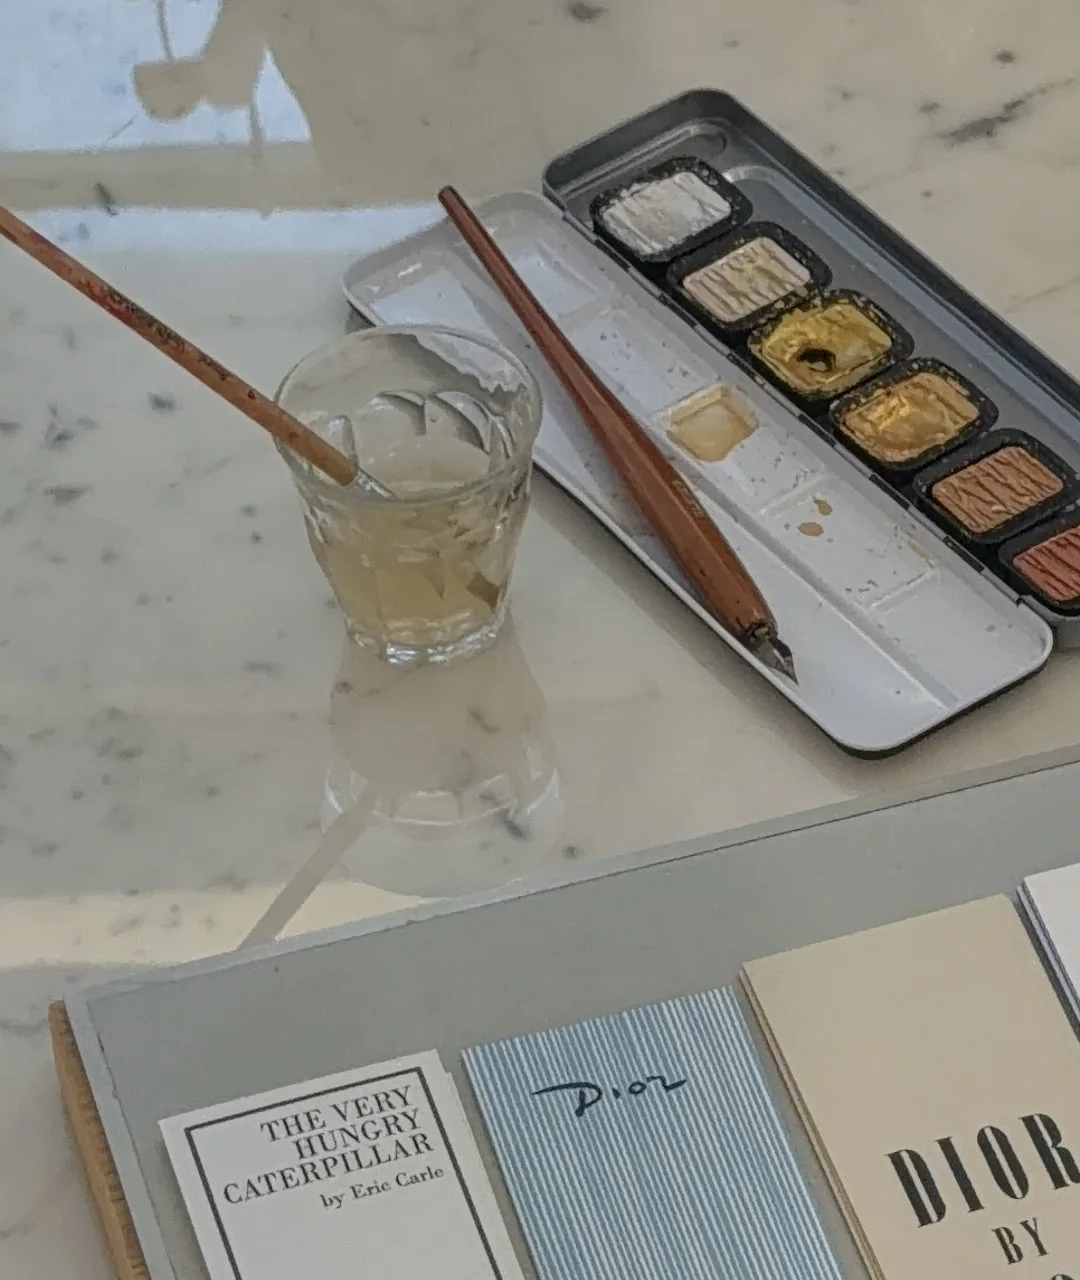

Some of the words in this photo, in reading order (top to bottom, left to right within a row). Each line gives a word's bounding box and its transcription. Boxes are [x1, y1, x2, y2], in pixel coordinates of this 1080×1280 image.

[260, 1108, 327, 1142] THE
[329, 1085, 413, 1122] VERY
[531, 1075, 688, 1118] Dior
[292, 1108, 422, 1160] HUNGRY
[223, 1132, 435, 1205] CATERPILLAR
[320, 1192, 344, 1209] by
[351, 1181, 391, 1200] Eric
[395, 1165, 445, 1187] Carle
[991, 1217, 1050, 1265] BY
